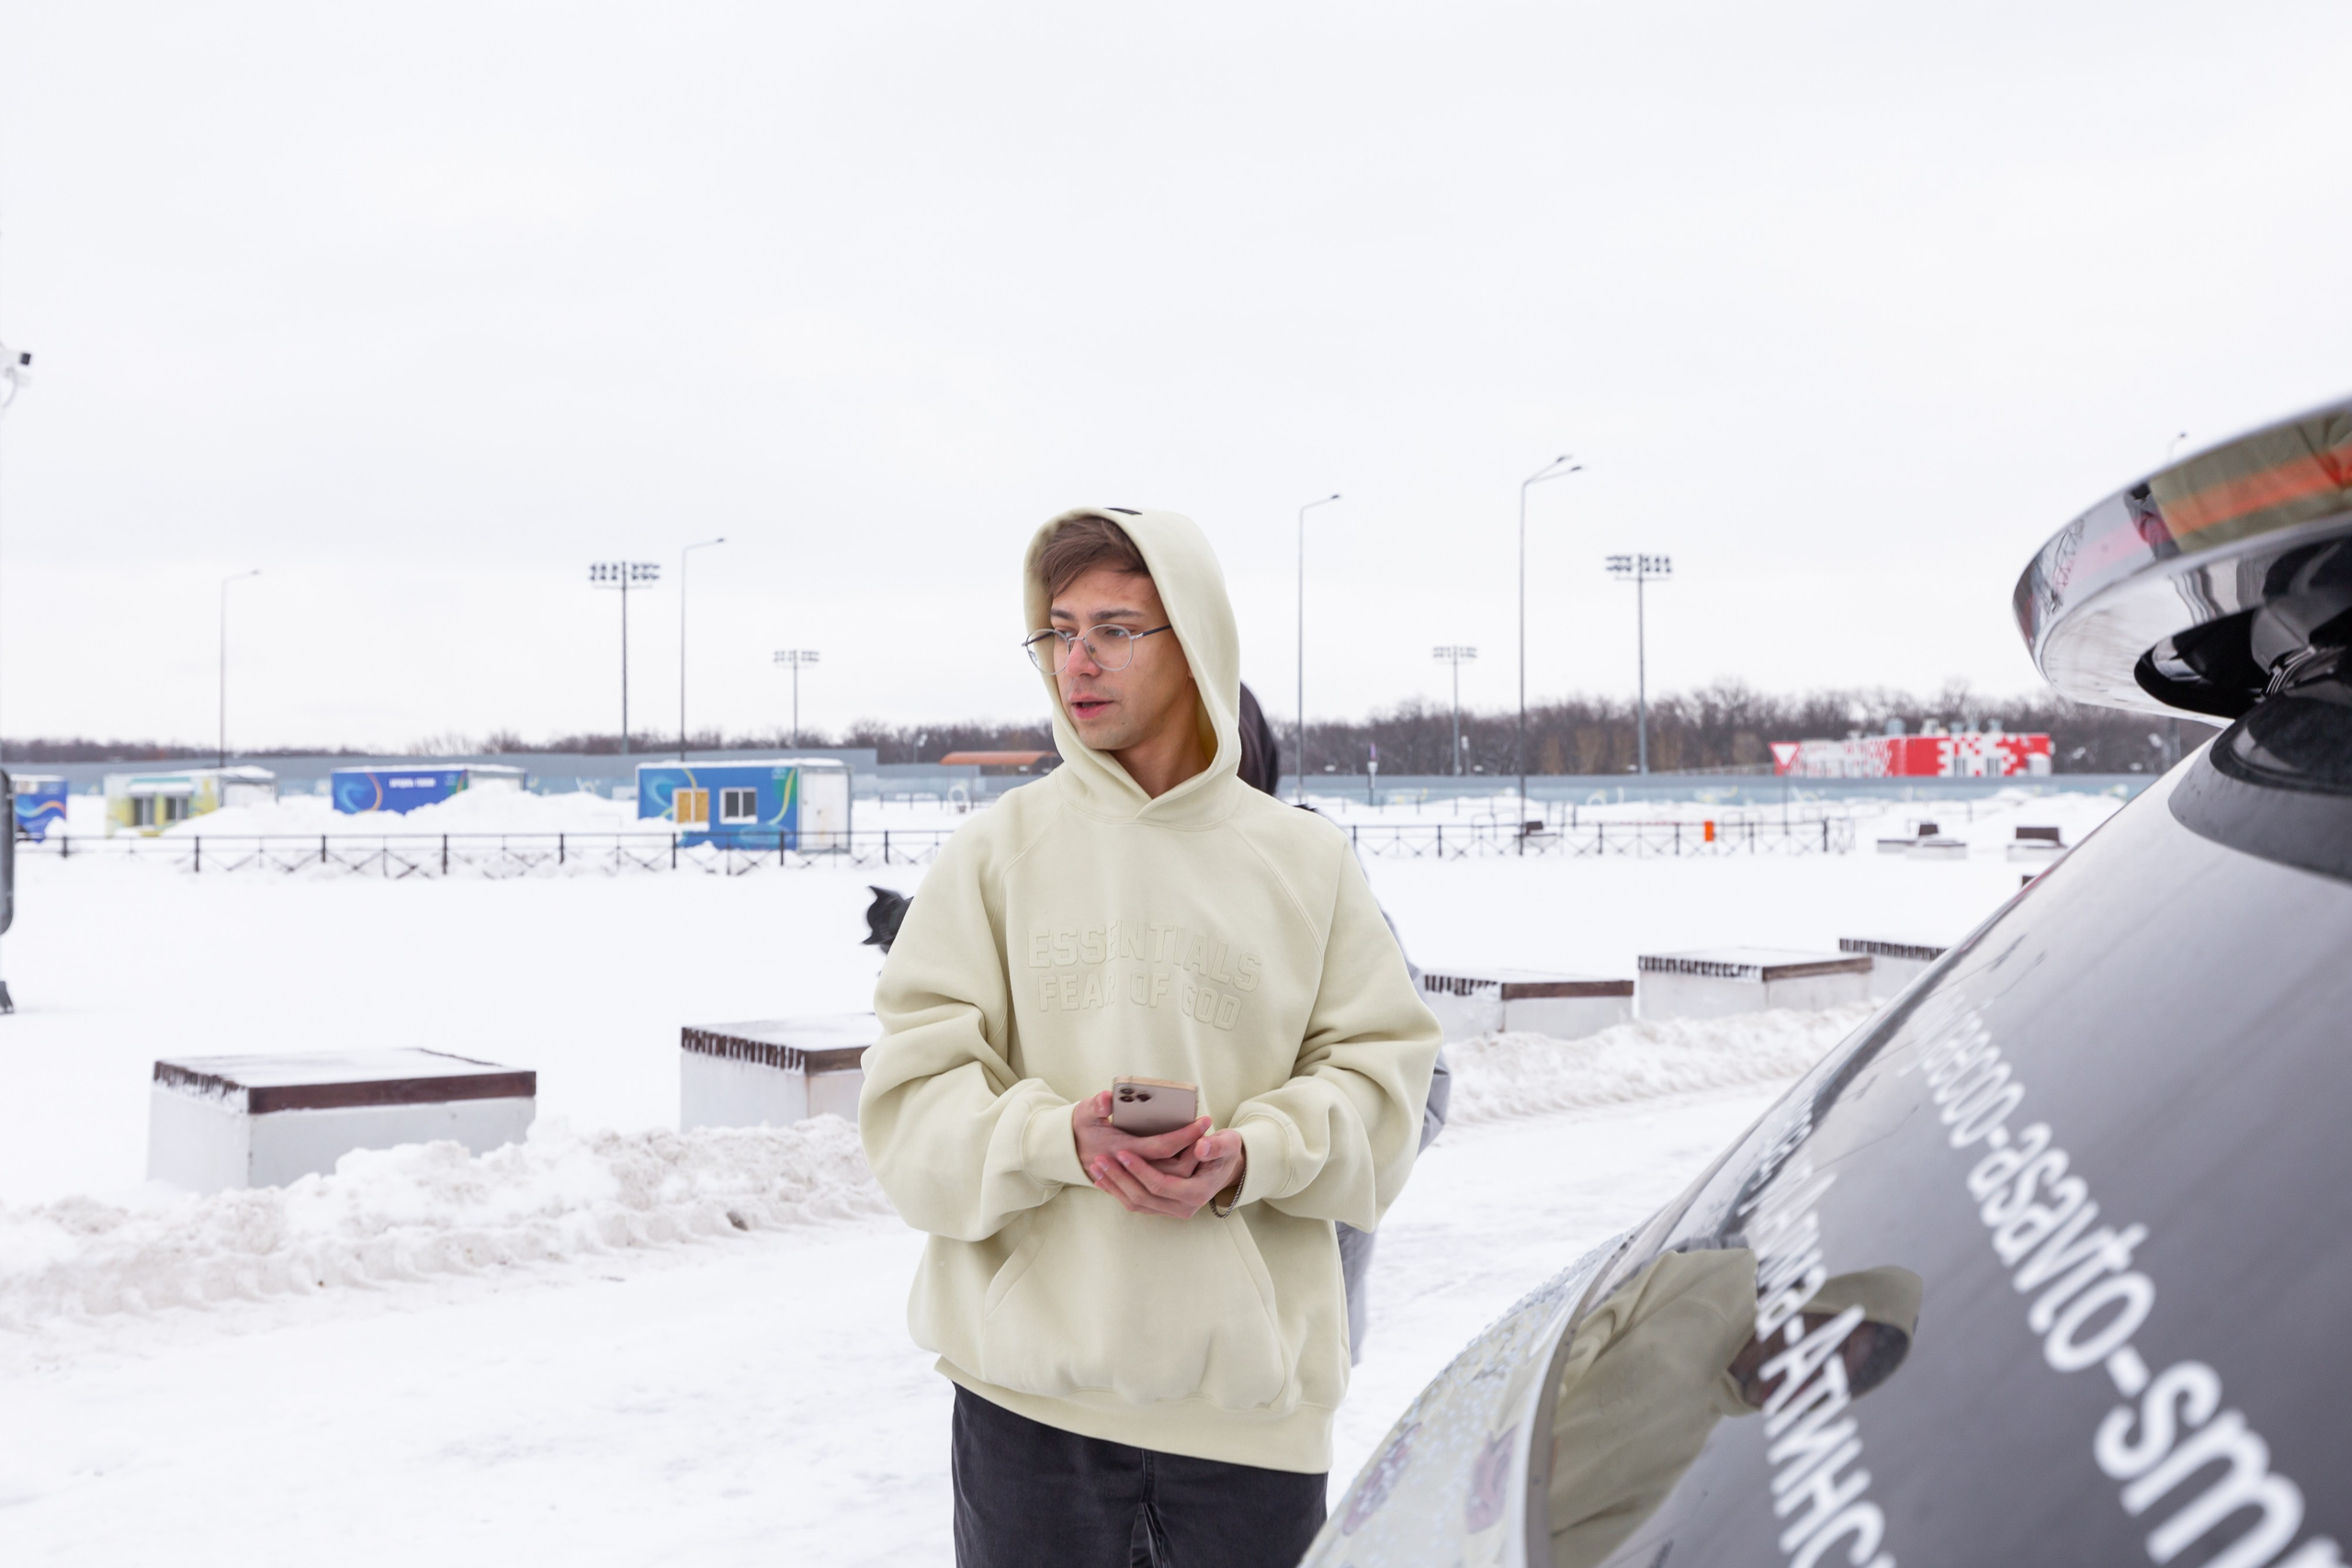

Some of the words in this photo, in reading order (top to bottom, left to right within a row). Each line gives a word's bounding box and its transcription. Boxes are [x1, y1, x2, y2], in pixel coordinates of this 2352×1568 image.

[1028, 919, 1261, 993] ESSENTIALS
[1039, 971, 1116, 1012] FEAR
[1131, 970, 1170, 1008] OF
[1182, 979, 1243, 1032] GOD
